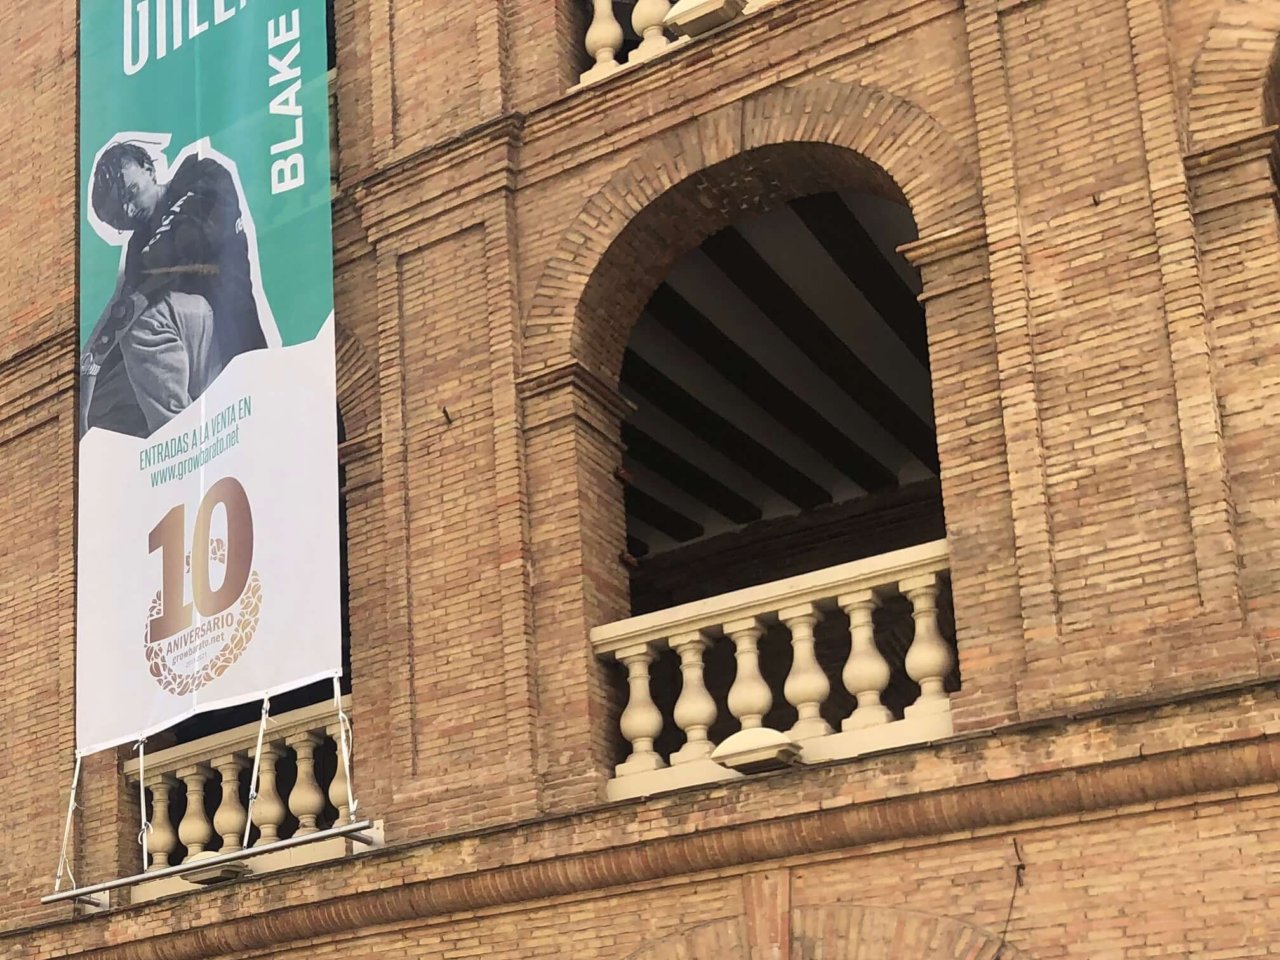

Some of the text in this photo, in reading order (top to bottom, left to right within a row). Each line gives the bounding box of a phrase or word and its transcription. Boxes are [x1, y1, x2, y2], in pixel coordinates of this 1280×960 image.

[267, 8, 305, 195] BLAKE
[140, 395, 252, 471] ENTRADAS A LA VENTA EN
[150, 424, 240, 488] www.growbarato.net
[147, 475, 255, 644] 10
[166, 612, 234, 656] ANIVERSARIO
